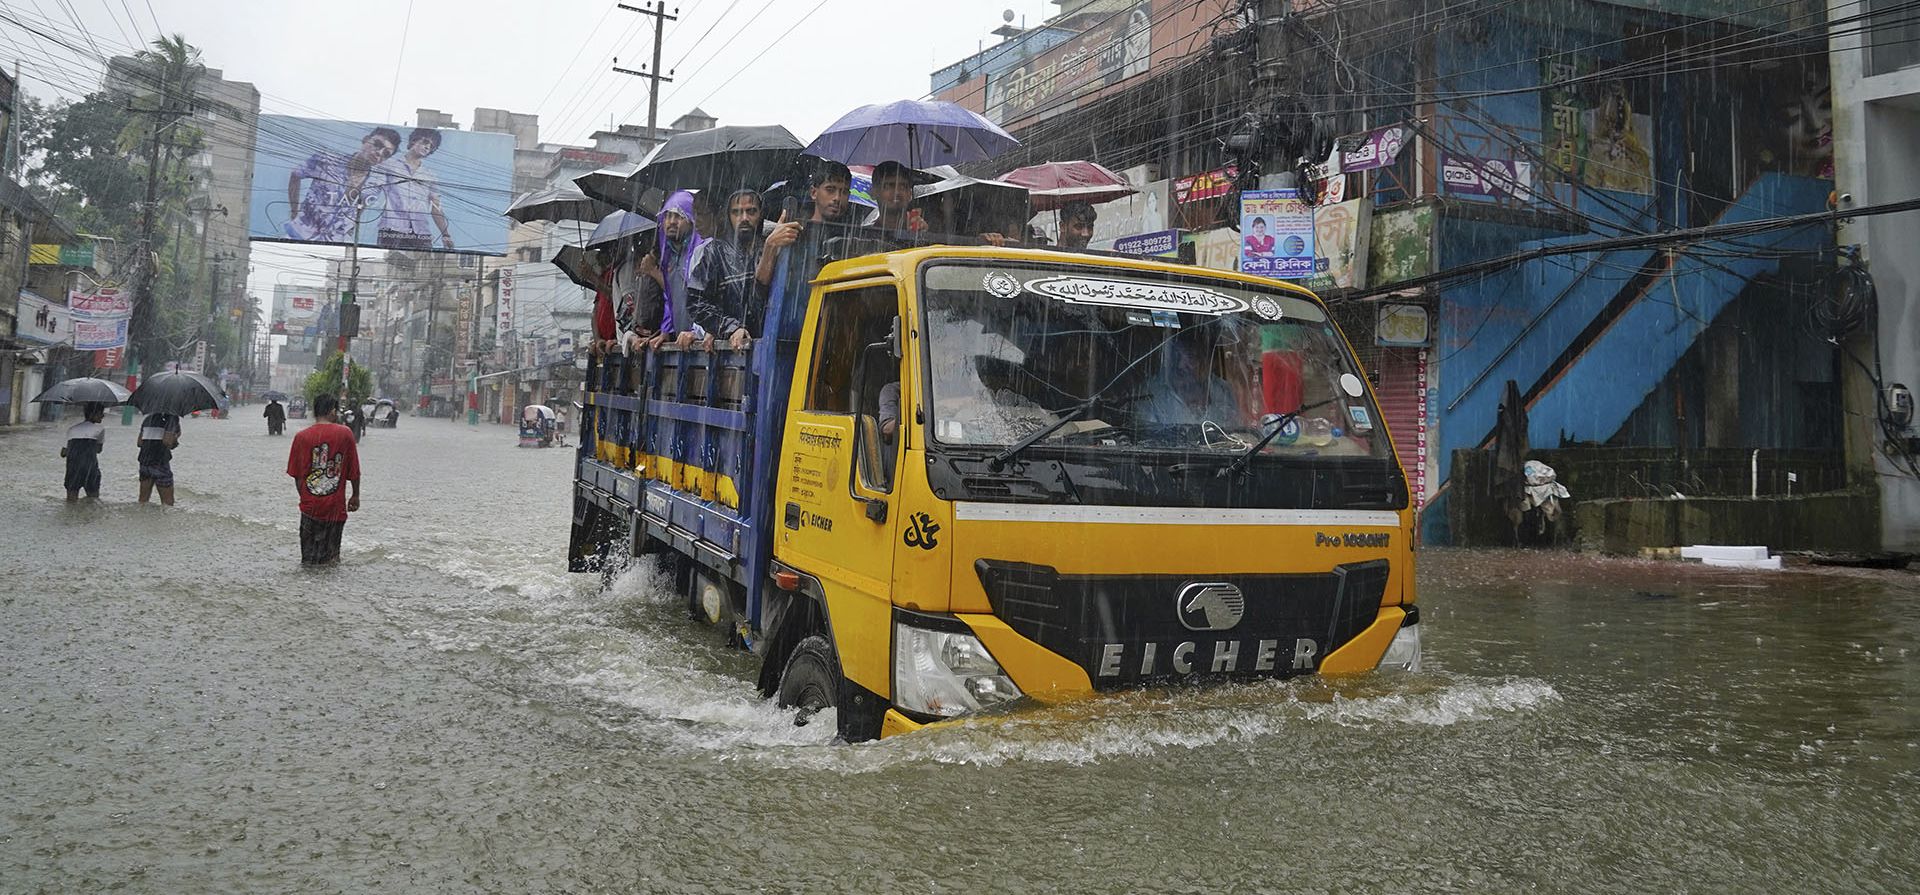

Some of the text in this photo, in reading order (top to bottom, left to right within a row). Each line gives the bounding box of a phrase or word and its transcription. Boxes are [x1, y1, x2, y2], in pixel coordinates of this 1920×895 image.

[1119, 235, 1172, 250] 01922-809729
[1243, 258, 1270, 270] ফেনী
[1274, 258, 1311, 270] ক্লিনিক
[811, 514, 833, 532] EICHER
[1314, 532, 1341, 547] Pro
[1098, 638, 1319, 677] EICHER
